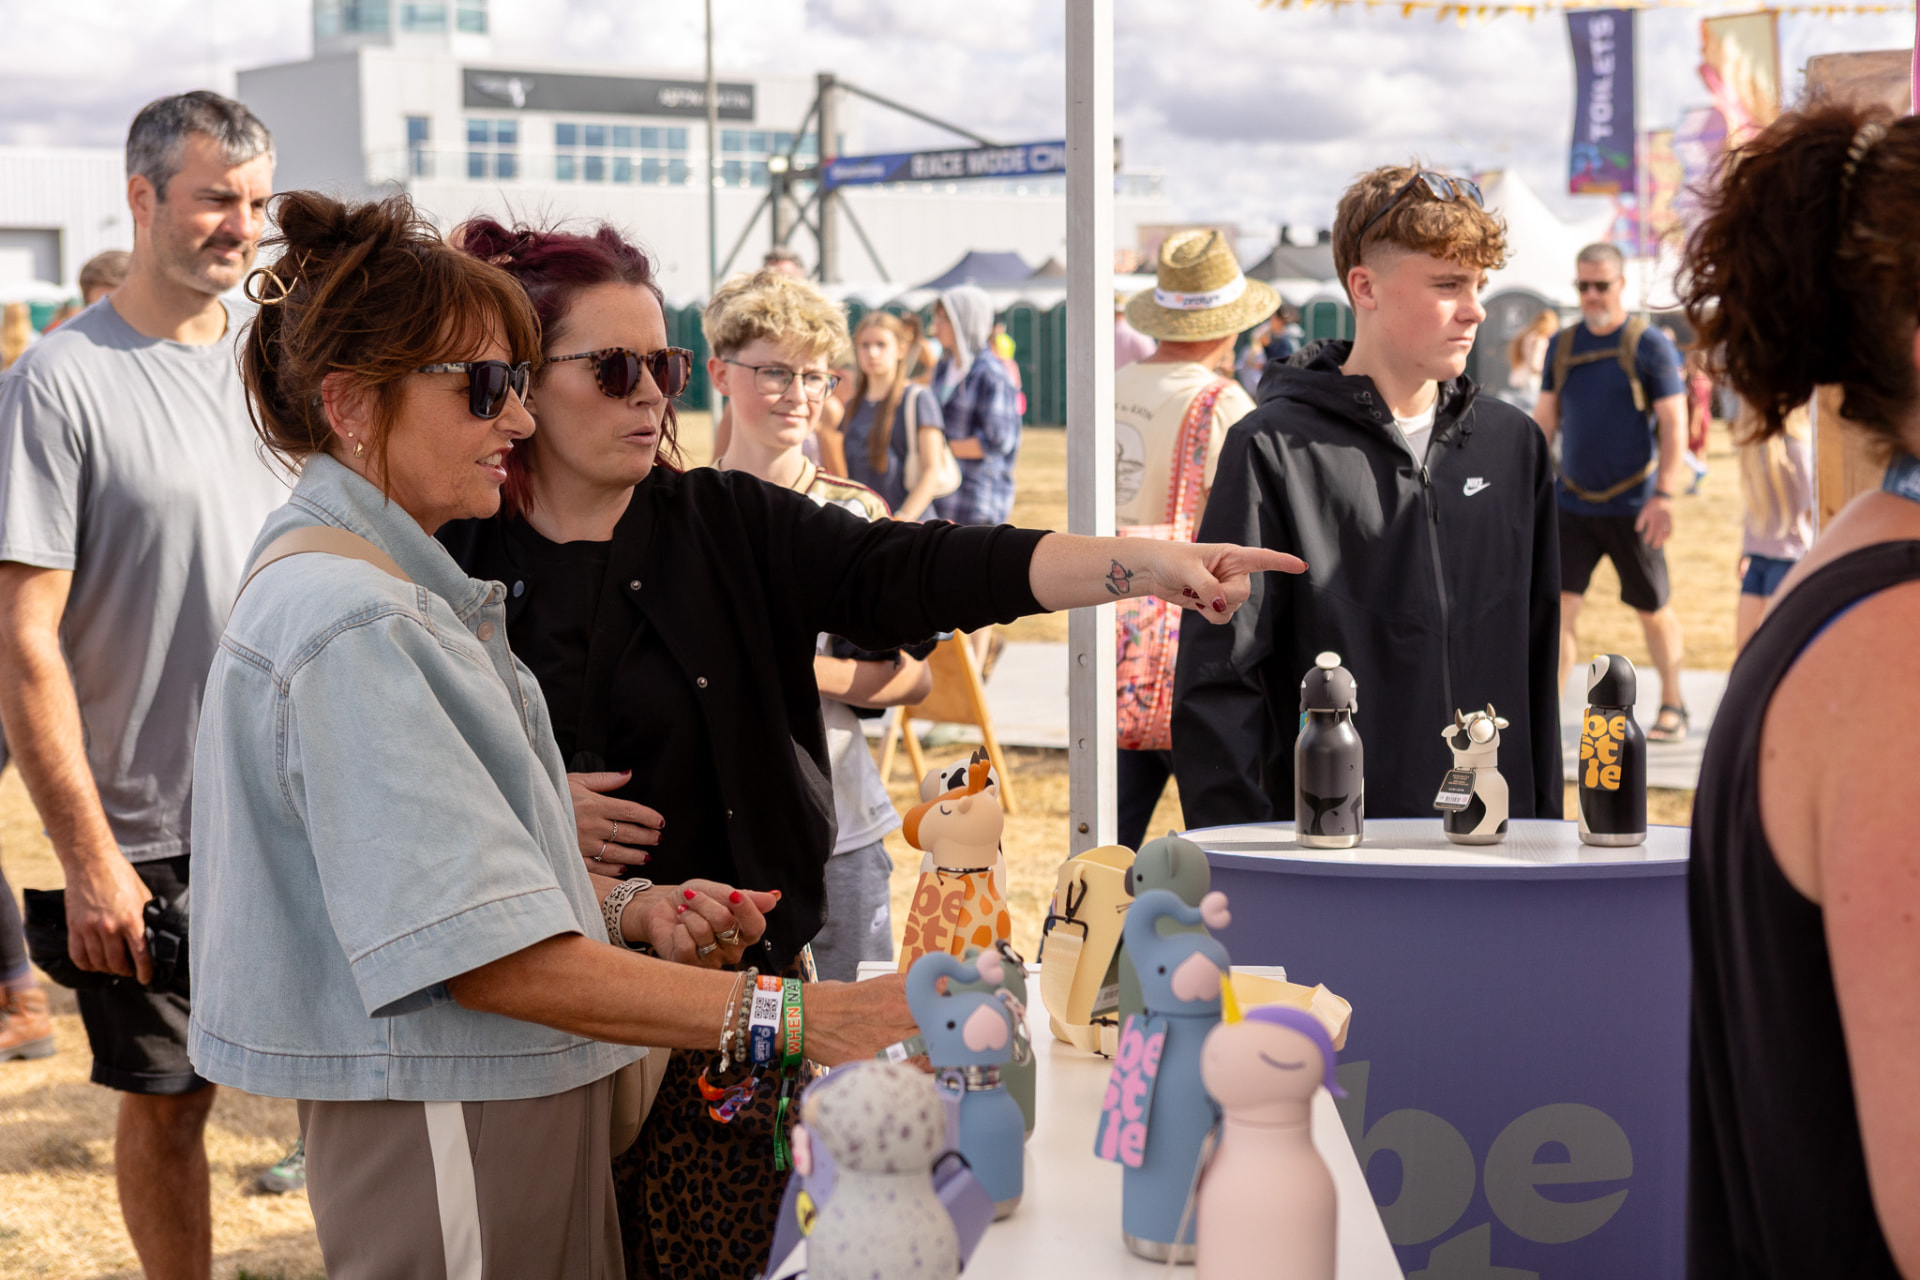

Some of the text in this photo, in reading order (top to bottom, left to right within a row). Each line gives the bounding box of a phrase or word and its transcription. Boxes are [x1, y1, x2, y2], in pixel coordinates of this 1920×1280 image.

[1588, 15, 1615, 143] TOILETS
[911, 154, 964, 178] RACE
[967, 148, 1027, 174] MODE
[787, 1006, 802, 1056] WHEN
